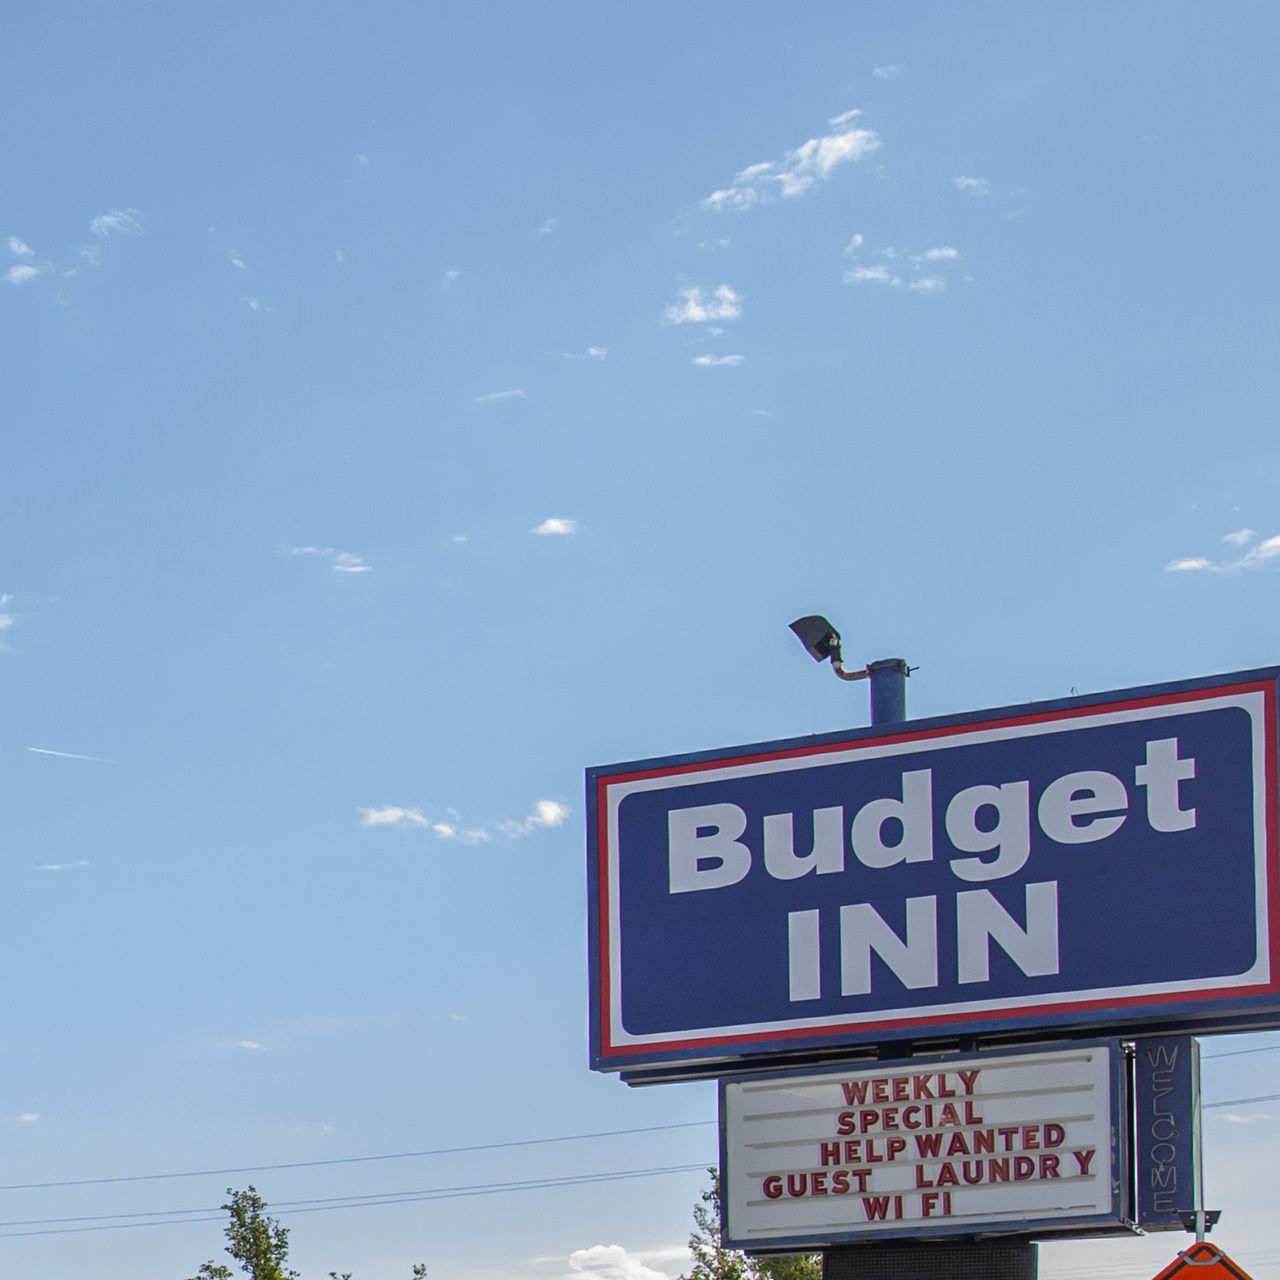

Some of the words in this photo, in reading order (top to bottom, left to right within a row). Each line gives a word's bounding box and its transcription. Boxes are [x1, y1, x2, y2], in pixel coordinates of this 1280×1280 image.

[667, 737, 1196, 894] Budget
[787, 881, 1060, 1002] INN
[841, 1070, 980, 1106] WEEKLY
[837, 1101, 983, 1135] SPECIAL
[1147, 1045, 1178, 1213] WELCOME
[820, 1137, 907, 1167] HELP
[915, 1123, 1066, 1158] WANTED
[763, 1168, 873, 1199] GUEST
[915, 1149, 1097, 1188] LAUNDRY
[862, 1196, 903, 1221] WI
[922, 1192, 952, 1217] FI
